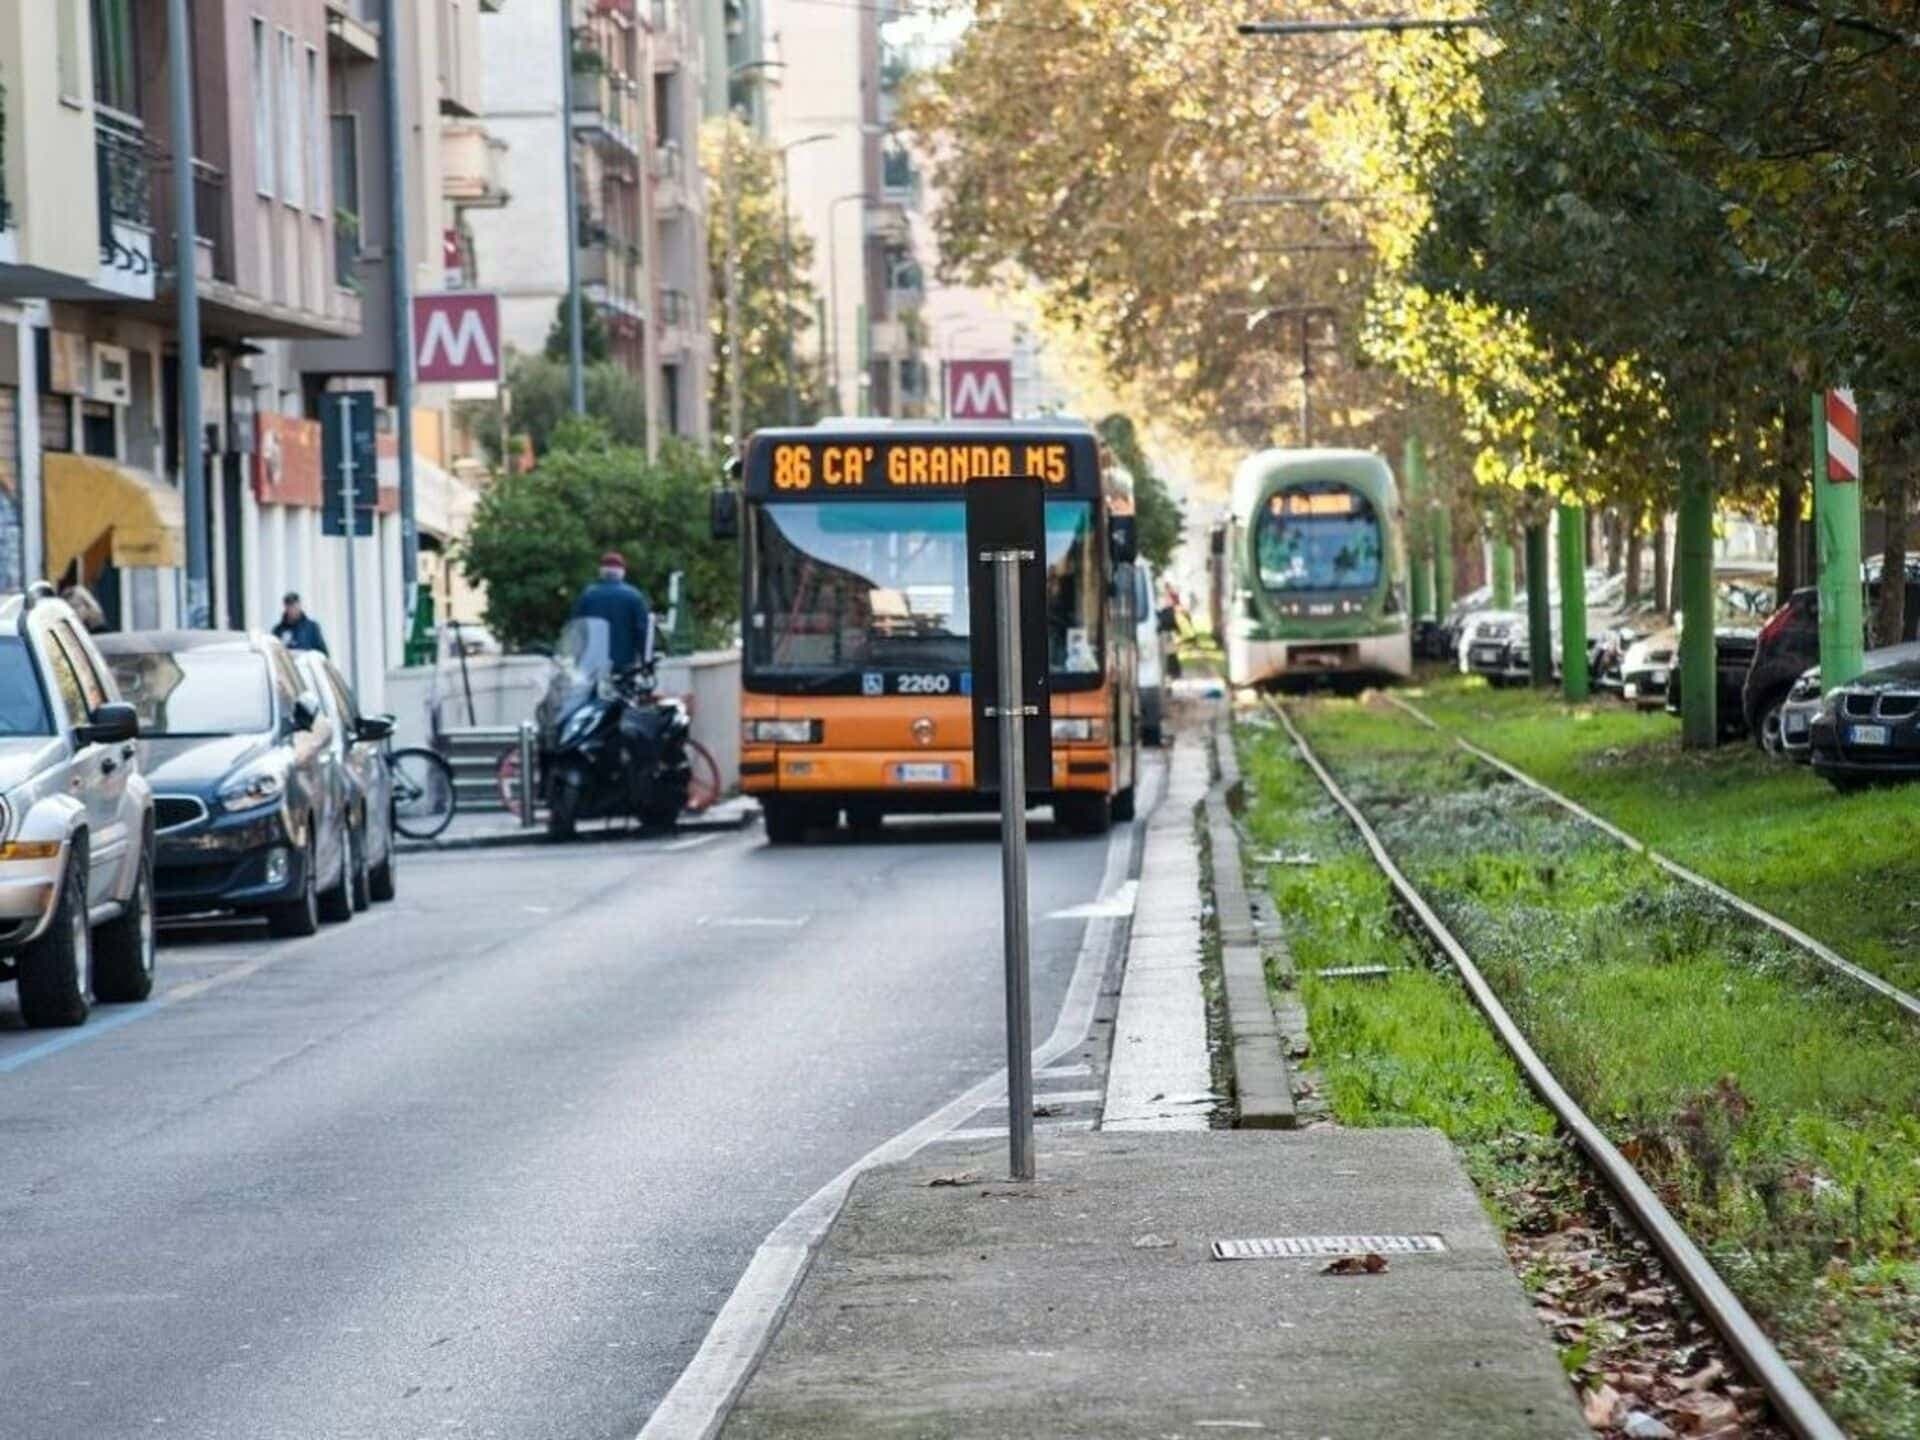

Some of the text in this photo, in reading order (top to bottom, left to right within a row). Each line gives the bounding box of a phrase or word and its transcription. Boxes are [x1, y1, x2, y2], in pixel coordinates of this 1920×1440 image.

[419, 310, 494, 366] M
[955, 372, 1007, 413] M
[774, 445, 1066, 489] 86 CA' GRANDA M5
[897, 674, 950, 693] 2260
